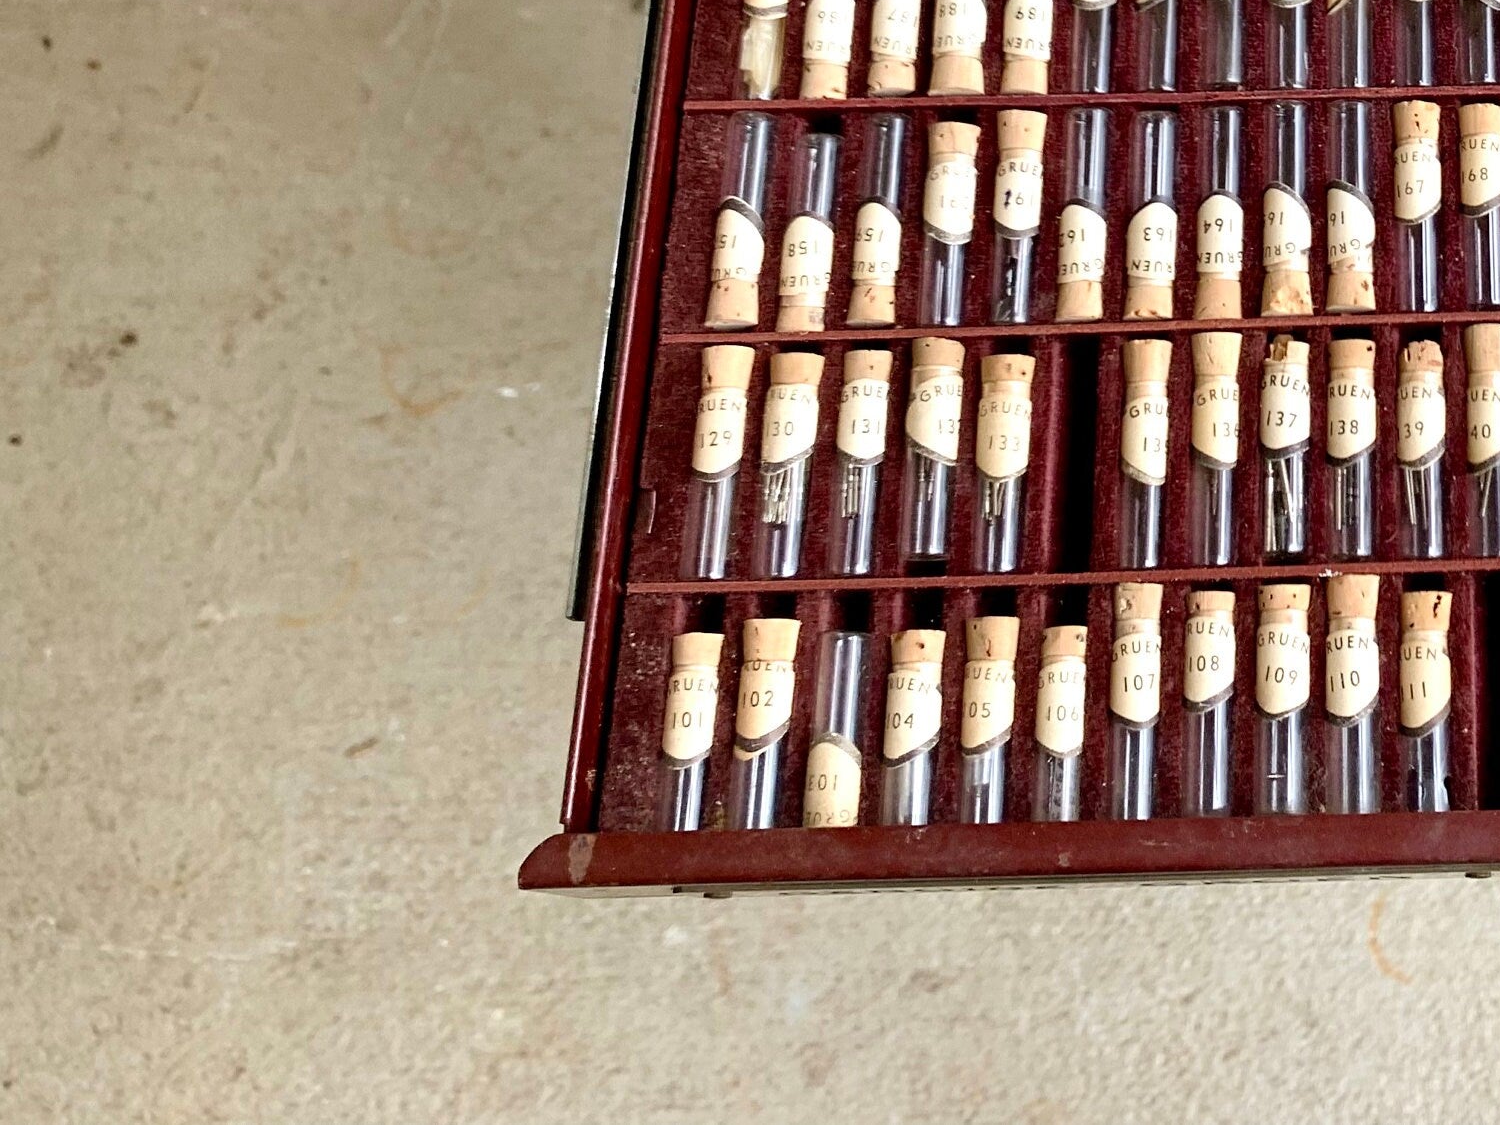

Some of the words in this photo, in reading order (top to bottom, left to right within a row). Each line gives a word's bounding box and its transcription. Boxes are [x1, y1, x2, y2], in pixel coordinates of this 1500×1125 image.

[1396, 180, 1425, 197] 167
[1144, 227, 1173, 241] 163
[1204, 219, 1232, 234] 164
[788, 241, 818, 257] 158
[851, 418, 881, 435] 131
[1266, 410, 1297, 428] 137
[1329, 419, 1358, 436] 138
[699, 430, 732, 448] 129
[988, 435, 1020, 451] 133
[1186, 655, 1219, 673] 108
[1123, 673, 1156, 693] 107
[1265, 665, 1298, 685] 109
[1329, 670, 1361, 693] 110
[742, 690, 775, 708] 102
[672, 711, 703, 729] 101
